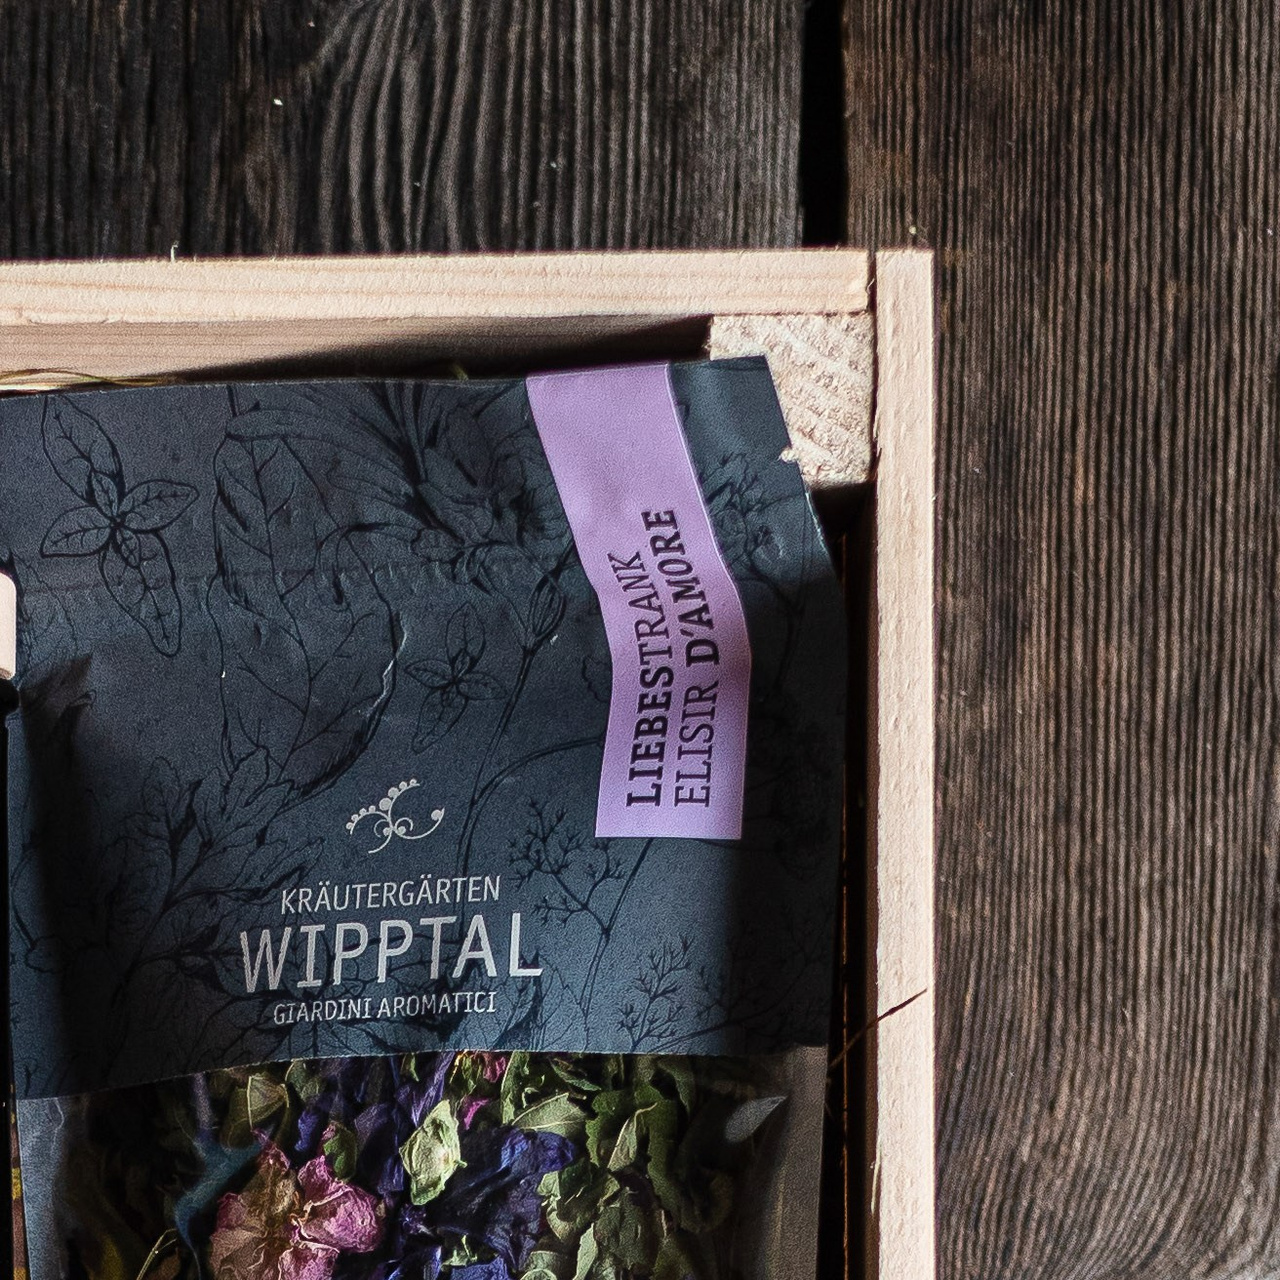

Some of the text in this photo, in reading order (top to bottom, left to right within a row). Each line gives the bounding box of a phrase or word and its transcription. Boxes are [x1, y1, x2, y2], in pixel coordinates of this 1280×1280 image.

[610, 552, 675, 807] LIEBESTRANK
[674, 680, 720, 808] ELISIR
[280, 876, 501, 914] KRÄUTERGÄRTEN
[239, 913, 544, 994] WIPPTAL
[273, 991, 498, 1026] GIARDINI AROMATICI
